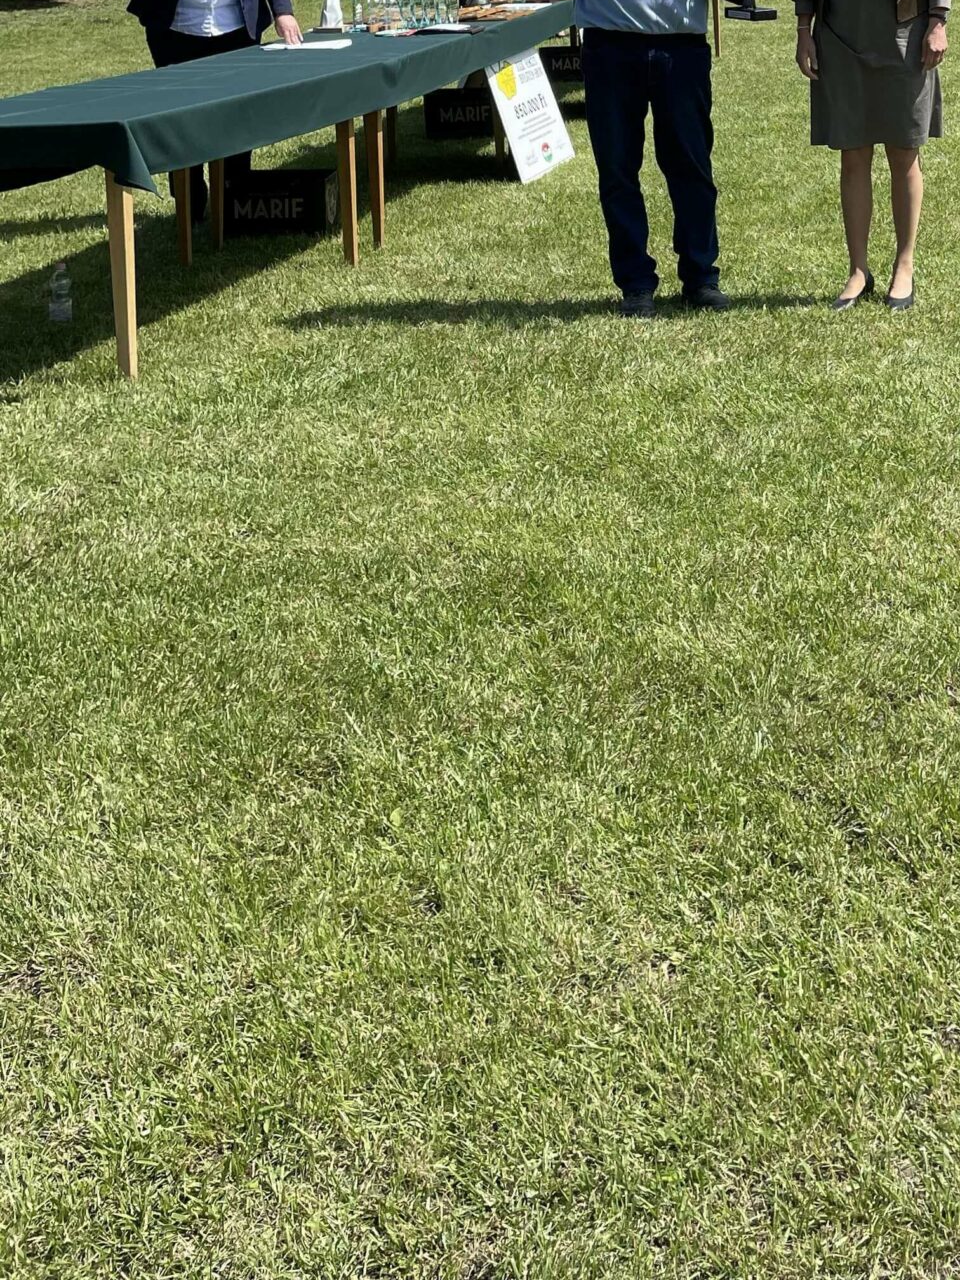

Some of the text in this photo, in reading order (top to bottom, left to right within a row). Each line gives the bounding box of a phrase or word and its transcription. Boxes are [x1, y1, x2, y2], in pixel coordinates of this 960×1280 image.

[552, 57, 580, 70] MAR
[440, 106, 490, 123] MARIF
[233, 198, 304, 219] MARIF
